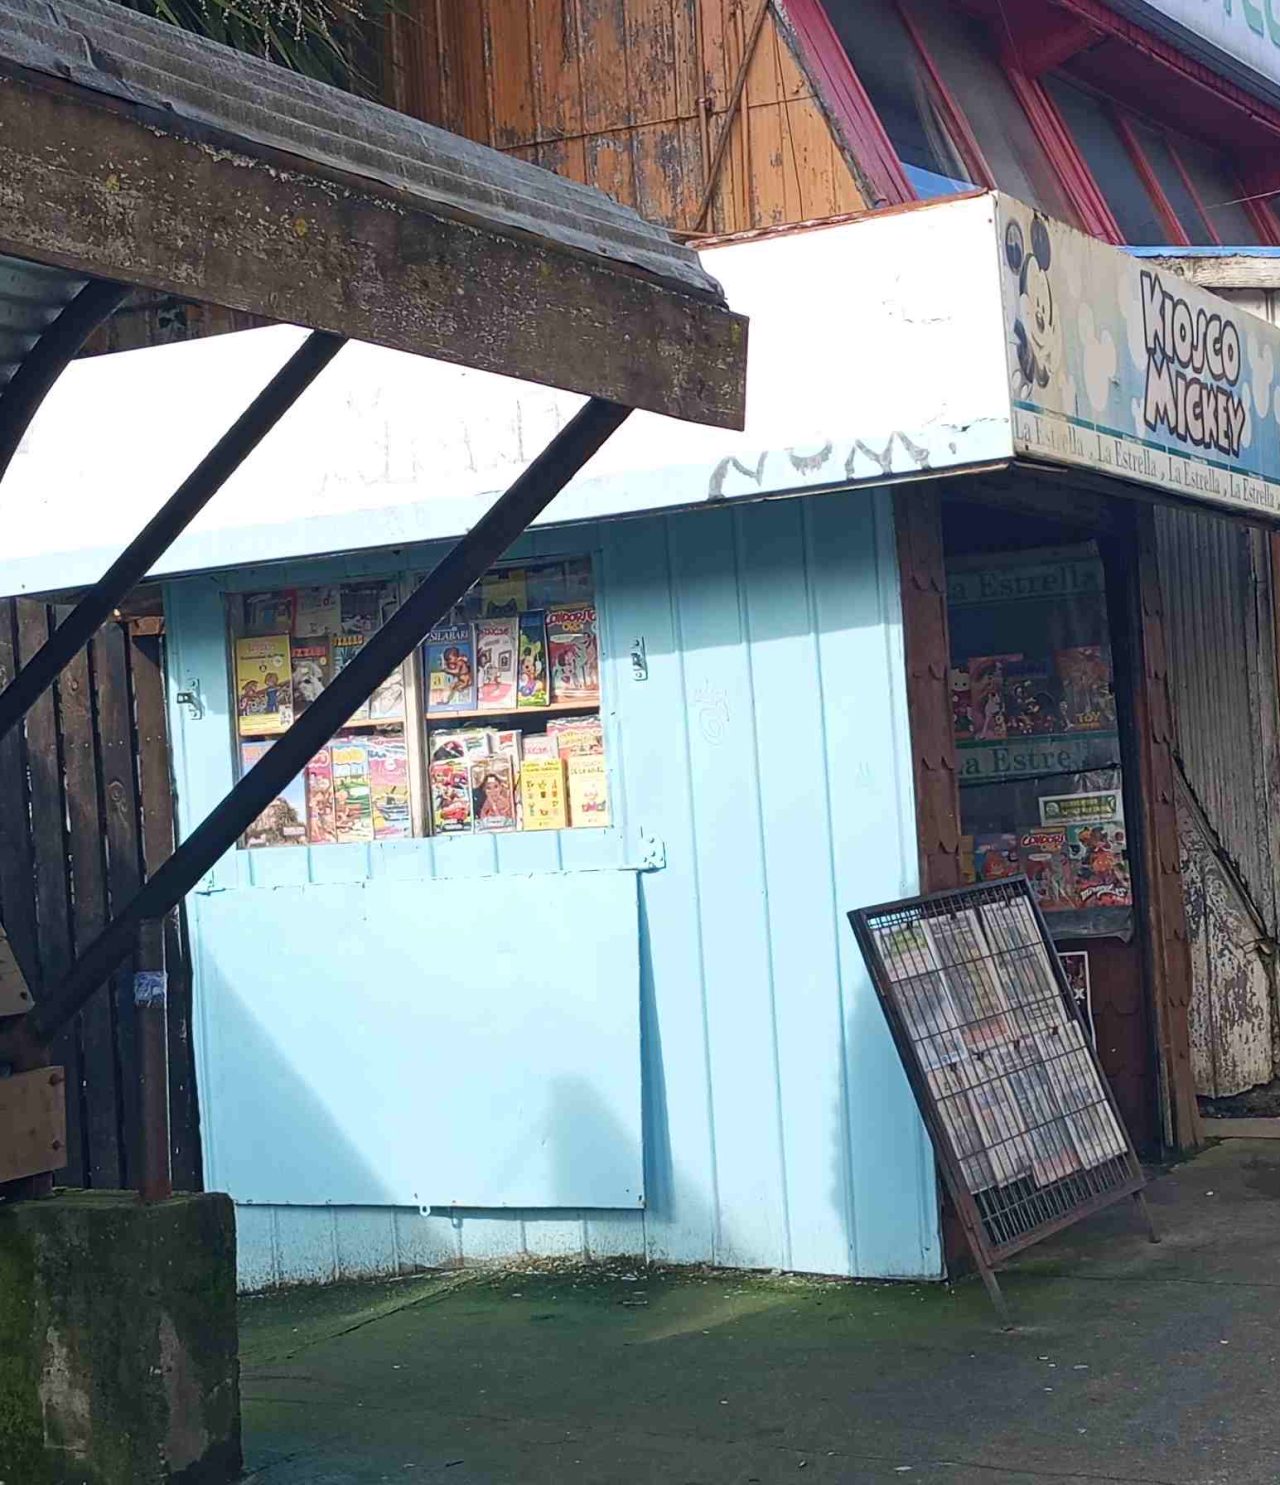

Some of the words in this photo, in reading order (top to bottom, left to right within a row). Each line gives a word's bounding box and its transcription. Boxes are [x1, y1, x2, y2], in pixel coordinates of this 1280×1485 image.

[1140, 269, 1241, 387] KIOSCO
[1144, 354, 1246, 459] MICKEY
[1015, 411, 1031, 444] La
[1097, 434, 1113, 465] La
[1114, 439, 1158, 478] Estrella
[1168, 456, 1182, 486] La
[1183, 460, 1221, 494] Estrella
[1229, 473, 1241, 500] La
[1242, 477, 1275, 509] Estrella
